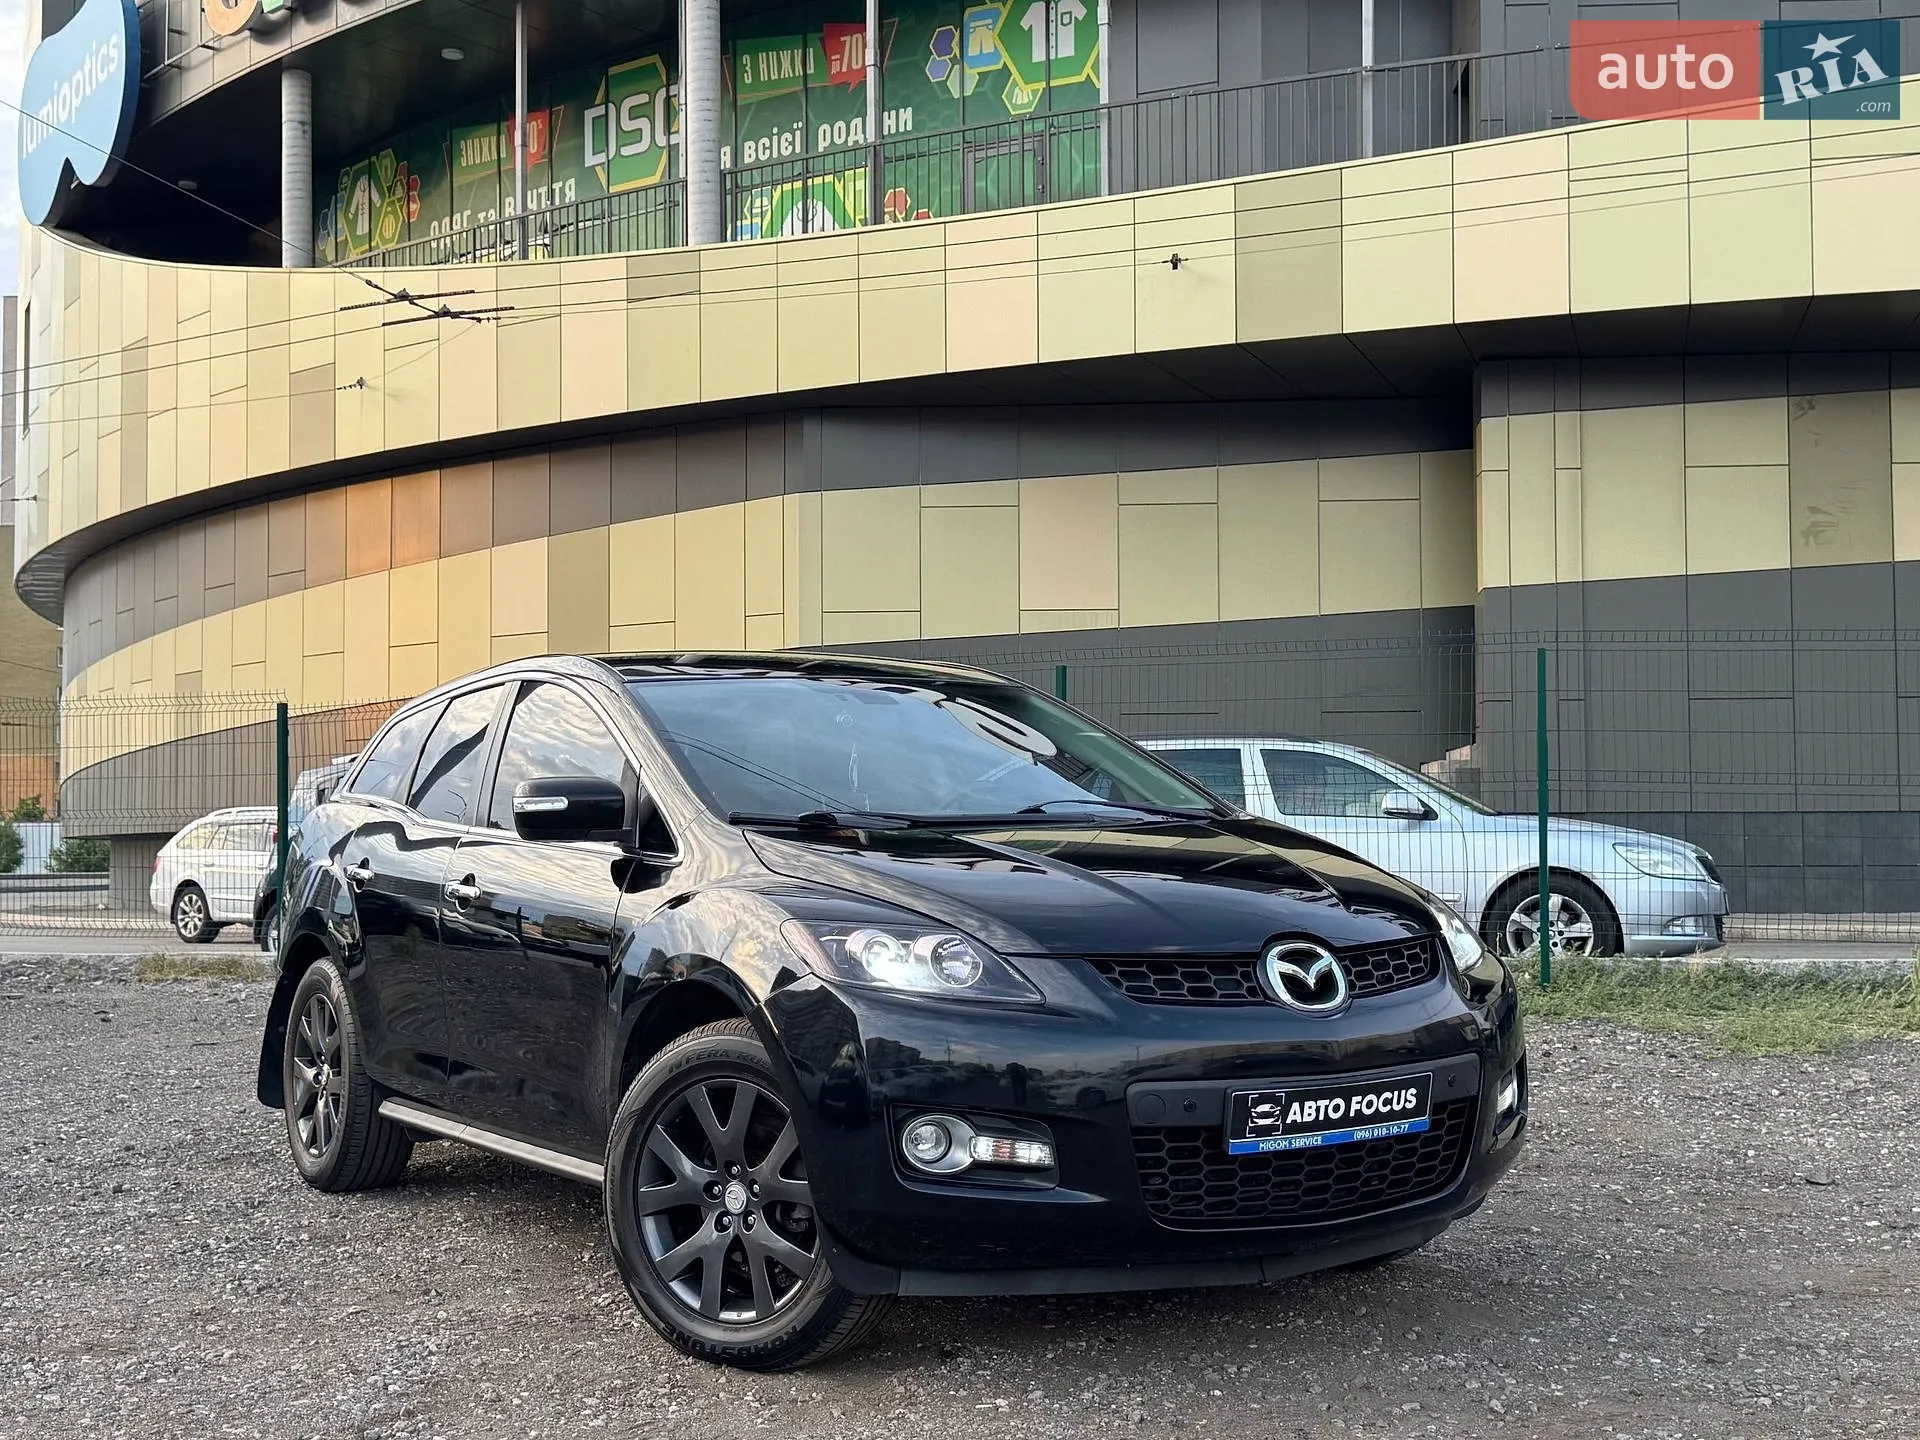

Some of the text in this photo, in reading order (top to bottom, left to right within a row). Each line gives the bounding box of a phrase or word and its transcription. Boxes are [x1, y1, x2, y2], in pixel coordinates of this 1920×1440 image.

[22, 33, 119, 160] lumioptics
[744, 121, 803, 164] всієї
[818, 107, 913, 152] родни
[1286, 1087, 1417, 1123] АВТО FOCUS
[1259, 1136, 1322, 1151] MIGOM SERVICE
[1354, 1124, 1409, 1141] (096) 010-10-77
